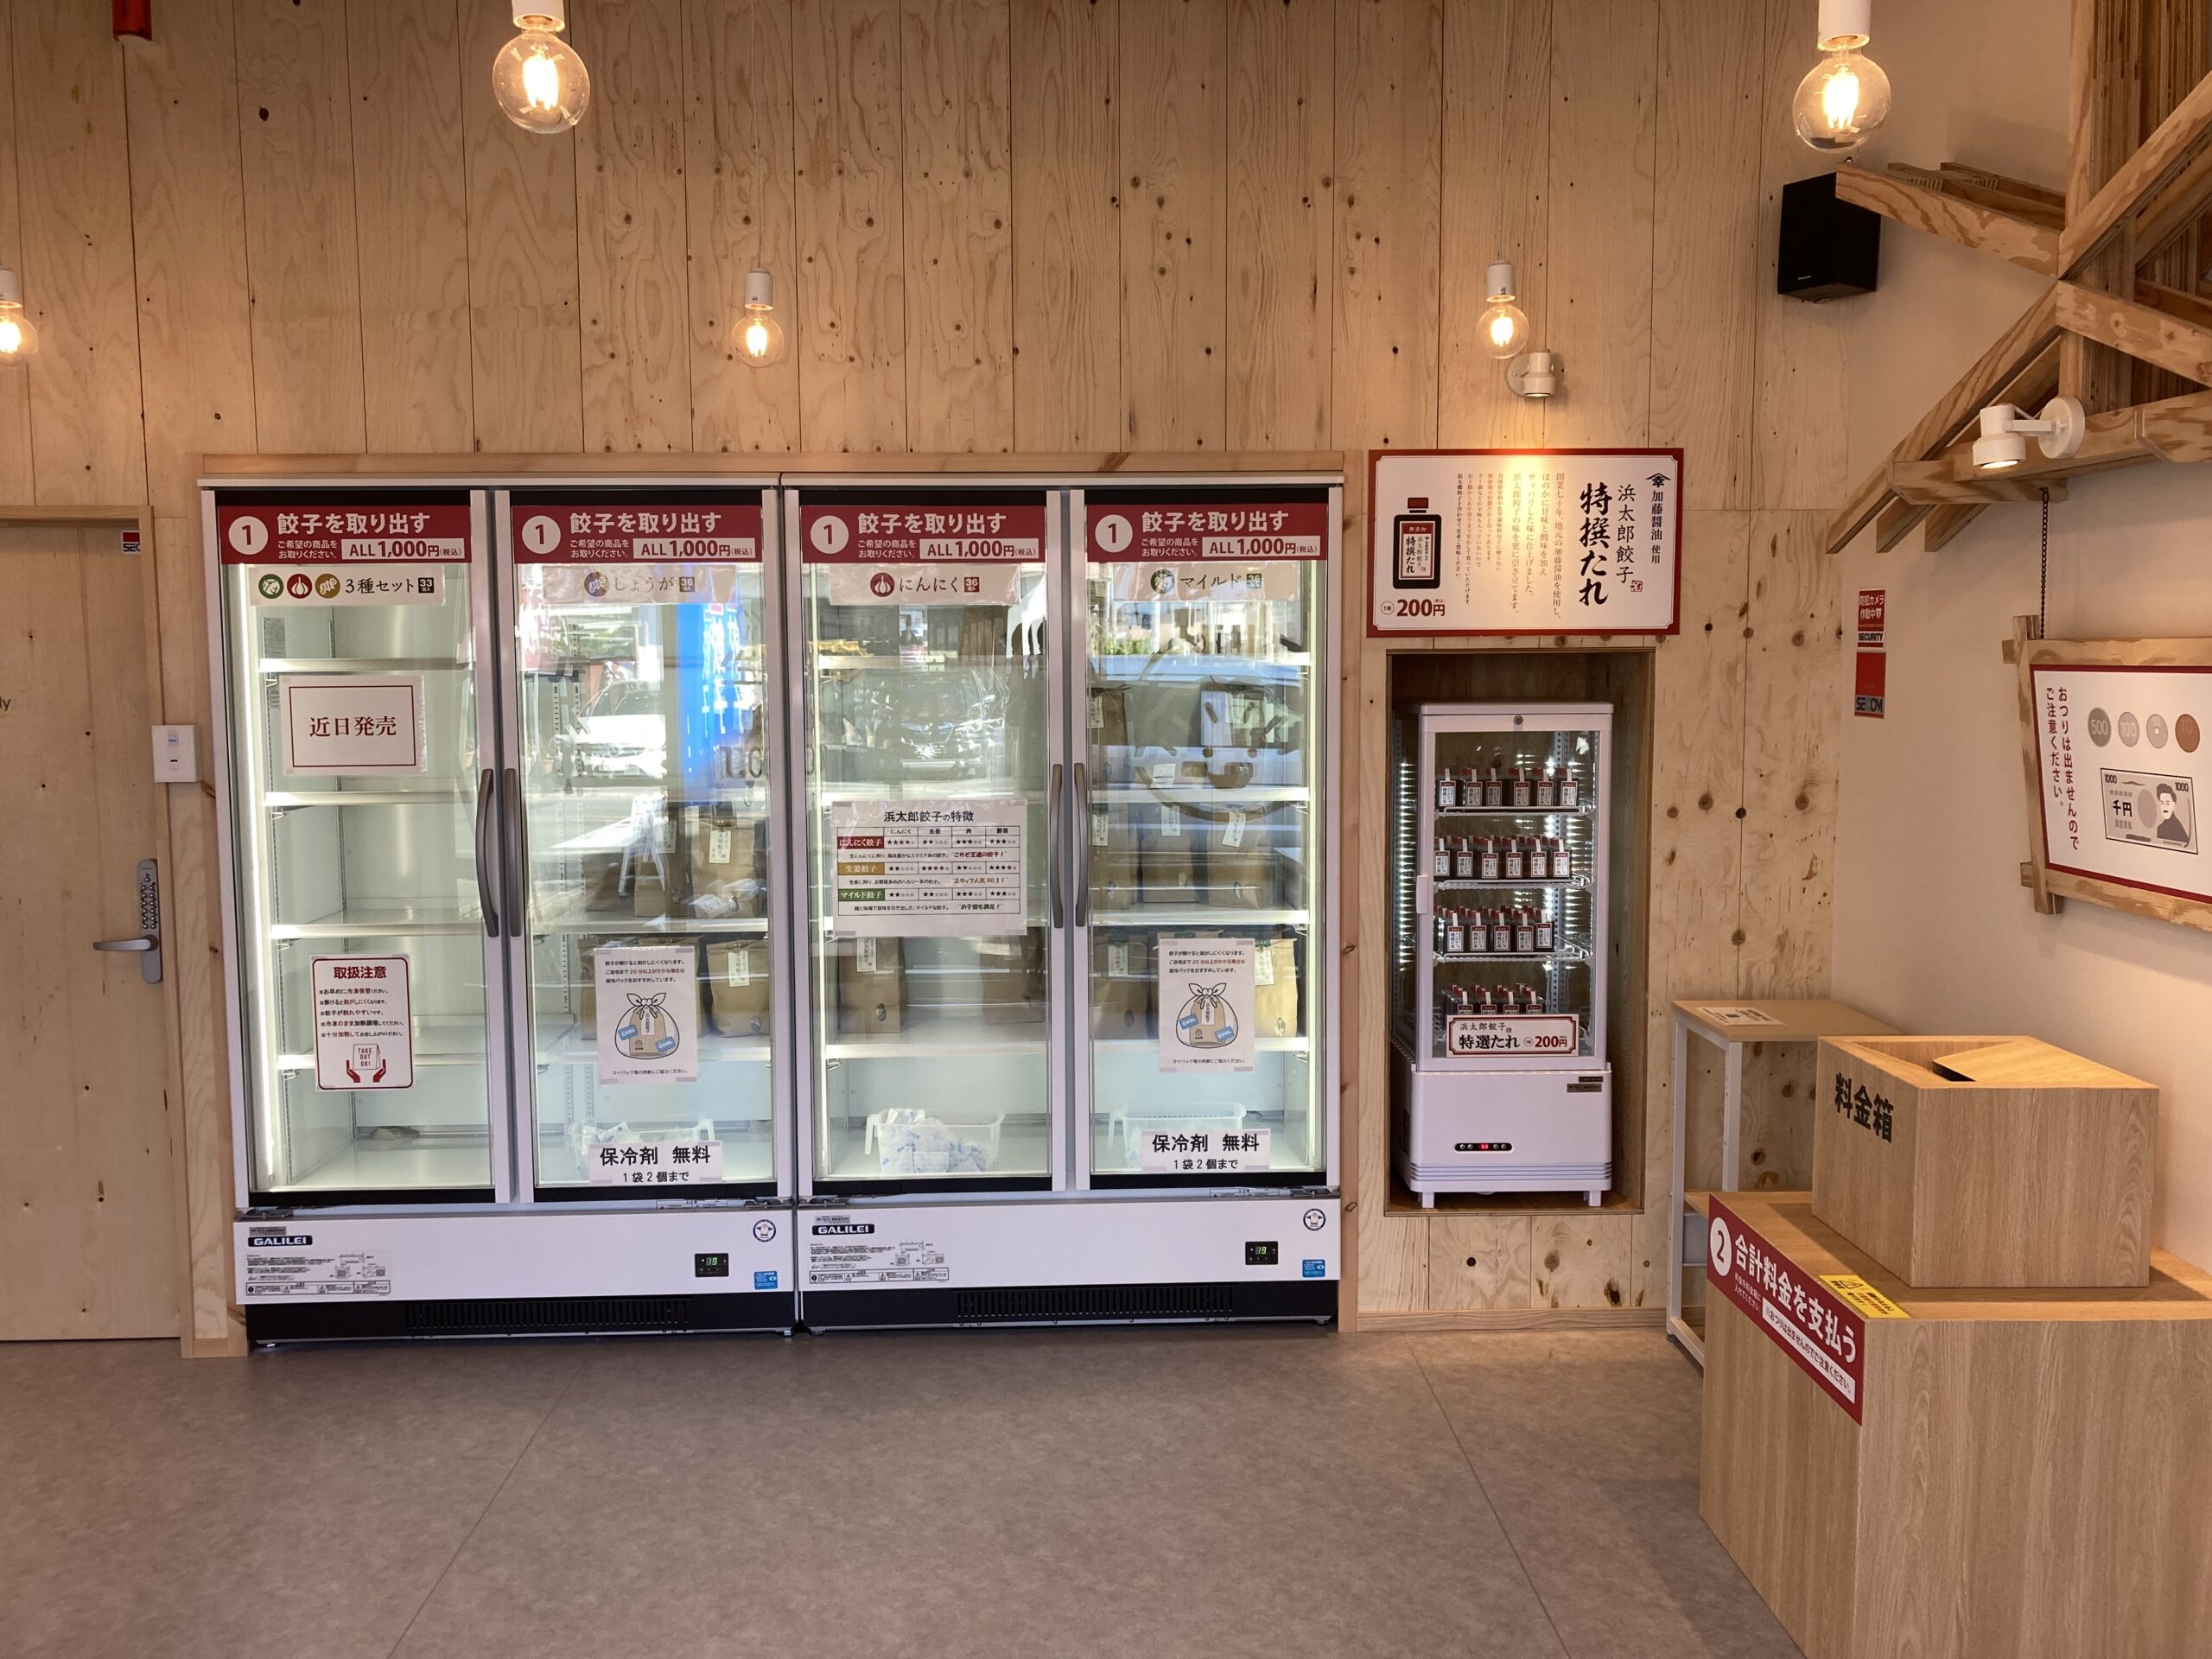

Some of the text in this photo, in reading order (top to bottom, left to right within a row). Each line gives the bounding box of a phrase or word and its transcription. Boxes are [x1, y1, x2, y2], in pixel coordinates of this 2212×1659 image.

[277, 512, 429, 534] 餃子を取り出す
[569, 512, 721, 534] 餃子を取り出す
[858, 512, 1007, 534] 餃子を取り出す
[1141, 511, 1288, 532] 餃子を取り出す
[242, 525, 251, 545] 1
[535, 524, 544, 544] 1
[823, 524, 833, 544] 1
[1108, 523, 1116, 543] 1
[1616, 484, 1636, 583] 浜太郎餃子
[277, 540, 337, 549] ご希望の商品を
[570, 539, 629, 548] ご希望の商品を
[858, 539, 916, 549] ご希望の商品を
[1141, 537, 1198, 546] ご希望の商品を
[1210, 542, 1234, 554] ALL
[1580, 482, 1612, 606] 特撰たれ
[278, 550, 337, 559] お取りください。
[349, 544, 375, 556] ALL
[571, 550, 628, 558] お取りください。
[641, 543, 666, 556] ALL
[859, 550, 915, 558] お取りください。
[927, 543, 952, 556] ALL
[1141, 548, 1198, 556] お取りください。
[1651, 545, 1660, 563] 使用
[346, 578, 414, 594] 3種セット
[614, 577, 674, 592] しょうが
[899, 577, 957, 593] にんにく
[966, 578, 978, 587] 36
[1180, 574, 1241, 590] マイルド
[1397, 599, 1445, 617] 200円
[1858, 632, 1883, 641] SECURITY
[1856, 697, 1883, 713] SEOM
[309, 716, 397, 737] 近日発売
[2091, 720, 2108, 735] 500
[2120, 722, 2137, 737] 100
[2046, 688, 2064, 806] ご注意ください。
[2058, 687, 2080, 850] おつりは出ませんので
[2105, 774, 2117, 784] 1000
[2175, 782, 2189, 791] 1000
[2113, 800, 2133, 817] 千円
[884, 810, 974, 823] 浜太郎餃子の特徴
[839, 838, 882, 847] にんにく餃子
[334, 966, 387, 979] 取扱注意
[1459, 1022, 1507, 1032] 浜太郎餃子
[1459, 1035, 1520, 1050] 特選たれ
[1535, 1036, 1567, 1048] 200円
[1834, 1072, 1893, 1143] 料金箱
[1152, 1133, 1260, 1153] 保冷剤 無料
[600, 1145, 711, 1166] 保冷剤 無料
[818, 1225, 869, 1234] GALILEI
[254, 1236, 307, 1246] GALILEI
[1717, 1230, 1725, 1263] 2
[1735, 1234, 1856, 1363] 合計料金を支払う
